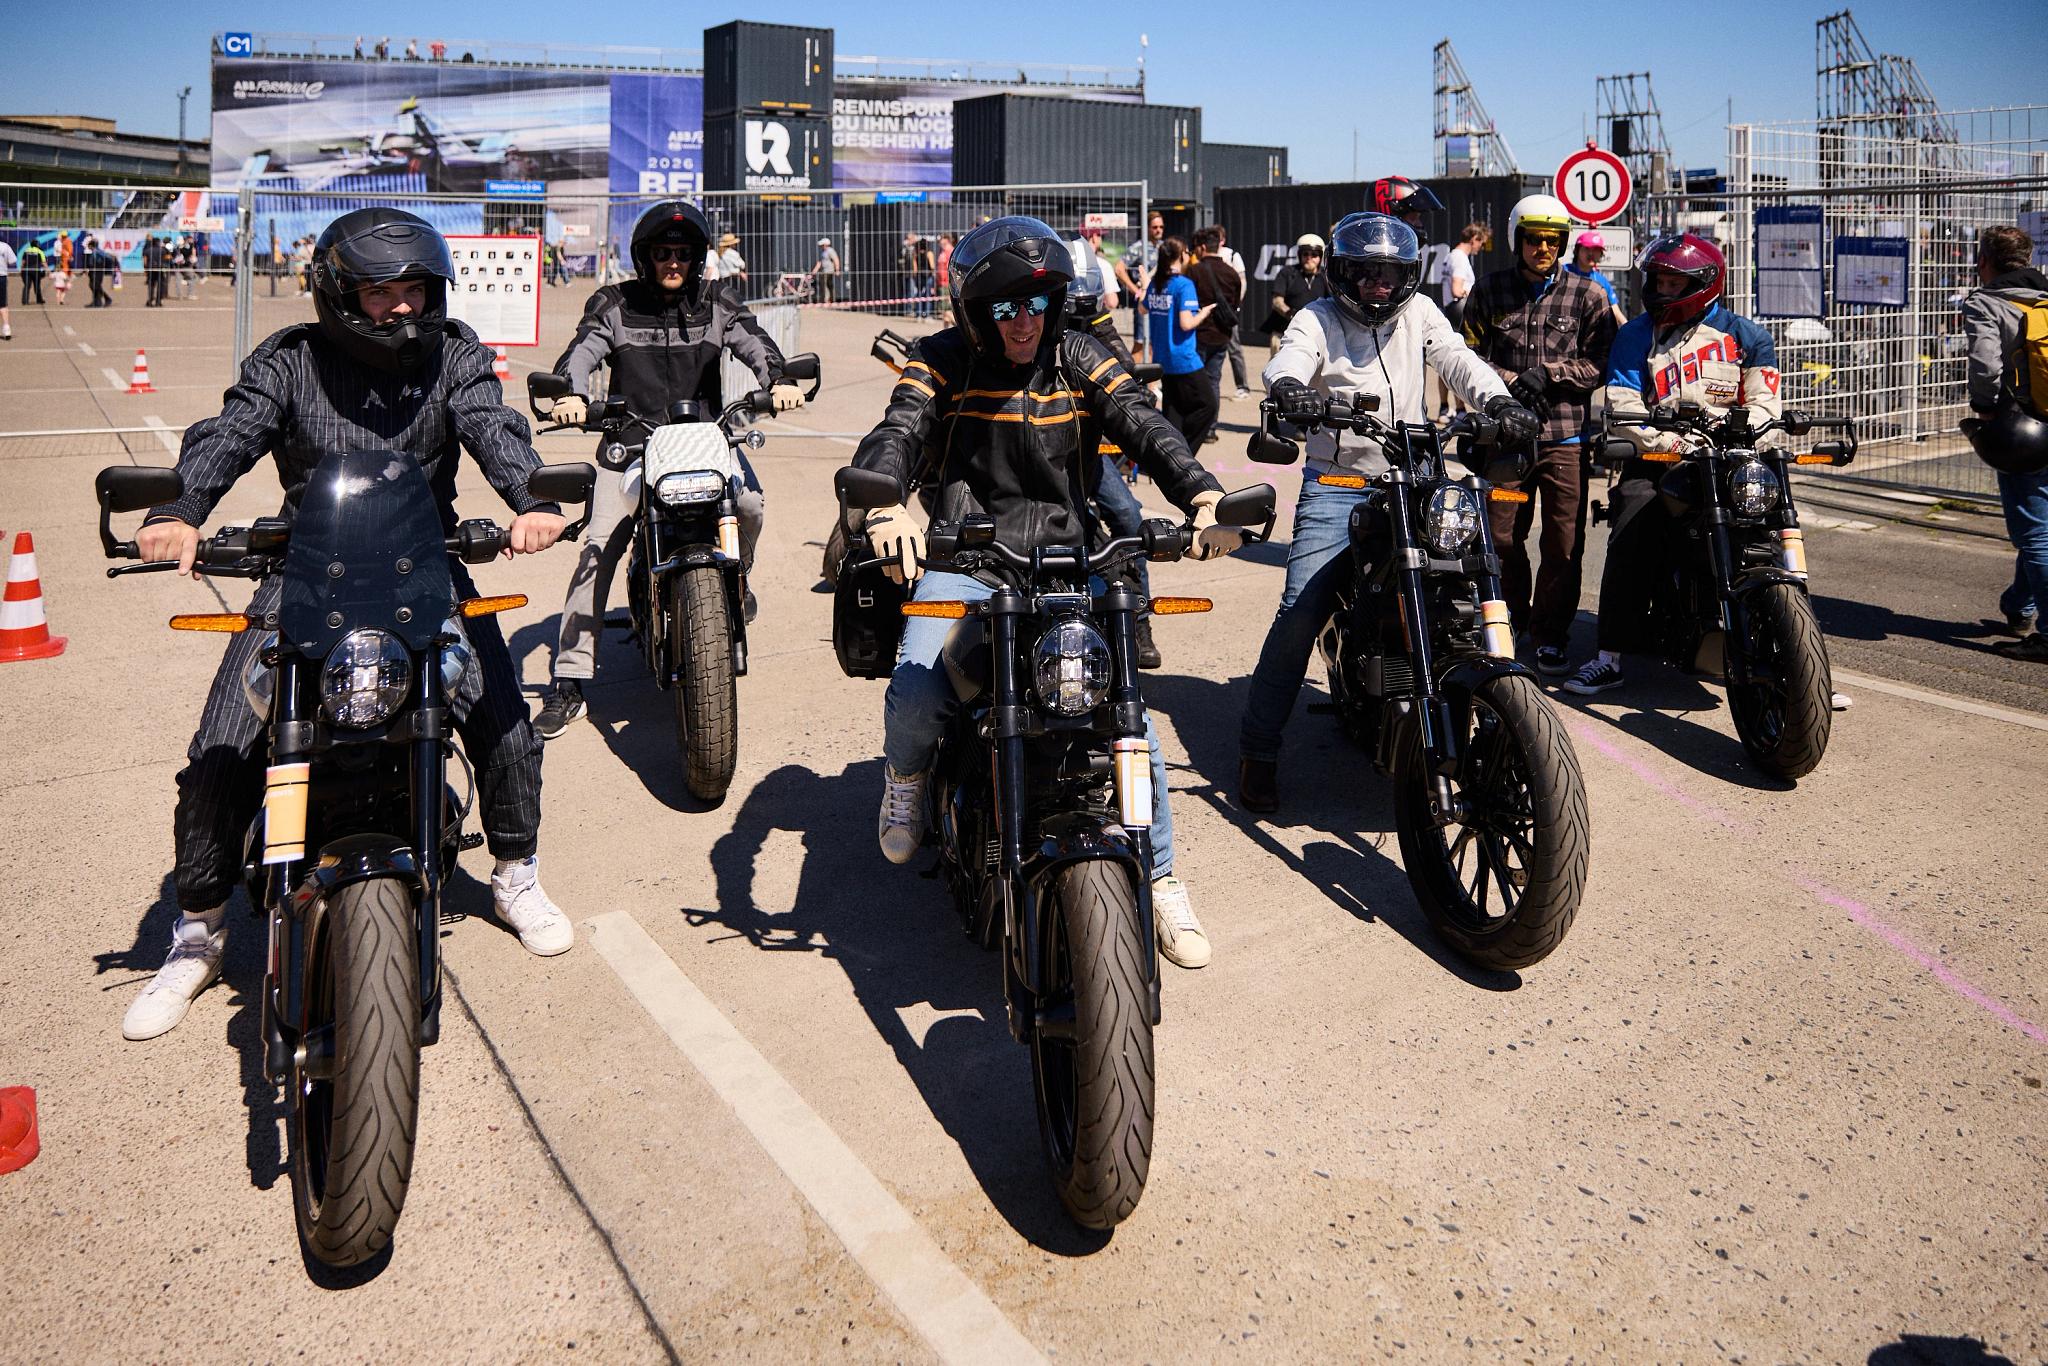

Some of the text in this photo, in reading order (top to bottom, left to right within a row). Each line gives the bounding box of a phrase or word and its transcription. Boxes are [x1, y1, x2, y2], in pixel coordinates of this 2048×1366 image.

[226, 36, 250, 53] C1
[832, 115, 859, 131] DU
[864, 116, 898, 132] IHN
[832, 131, 925, 149] GESEHEN
[648, 157, 693, 169] 2026
[639, 171, 703, 199] BE
[1575, 170, 1610, 201] 10
[104, 240, 131, 250] ABB
